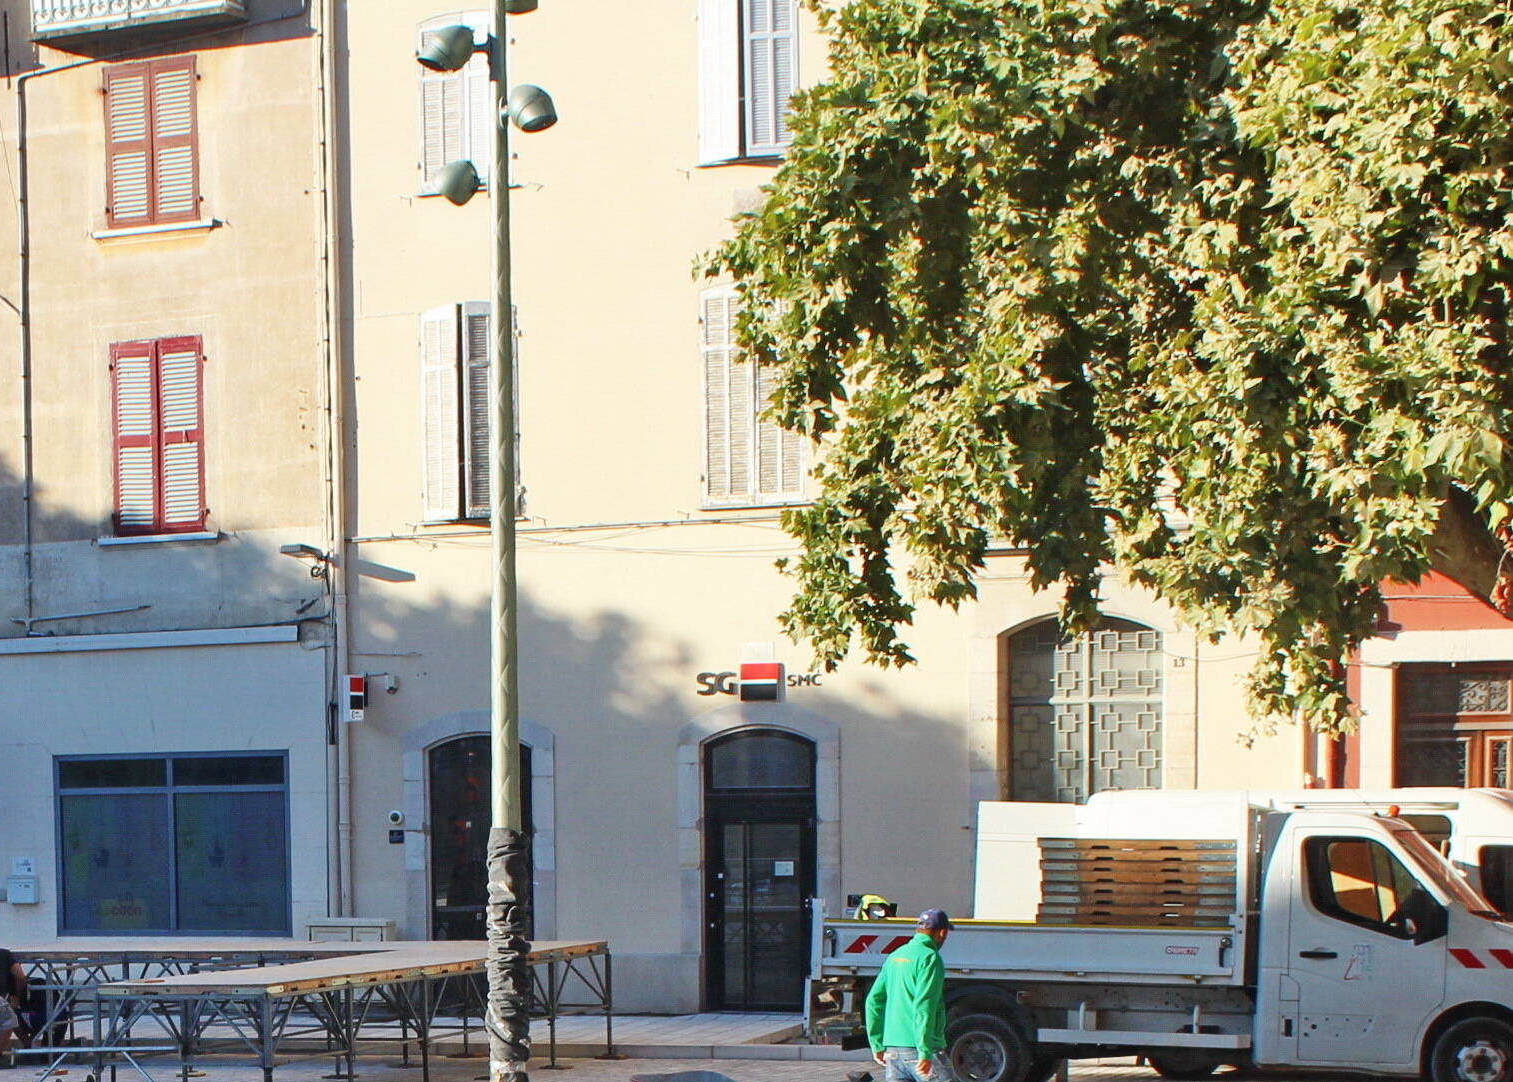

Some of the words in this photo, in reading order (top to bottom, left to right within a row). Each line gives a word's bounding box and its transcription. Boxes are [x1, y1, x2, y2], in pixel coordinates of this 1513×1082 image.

[1173, 657, 1185, 667] 13
[696, 672, 738, 695] SG
[787, 674, 822, 686] SMC
